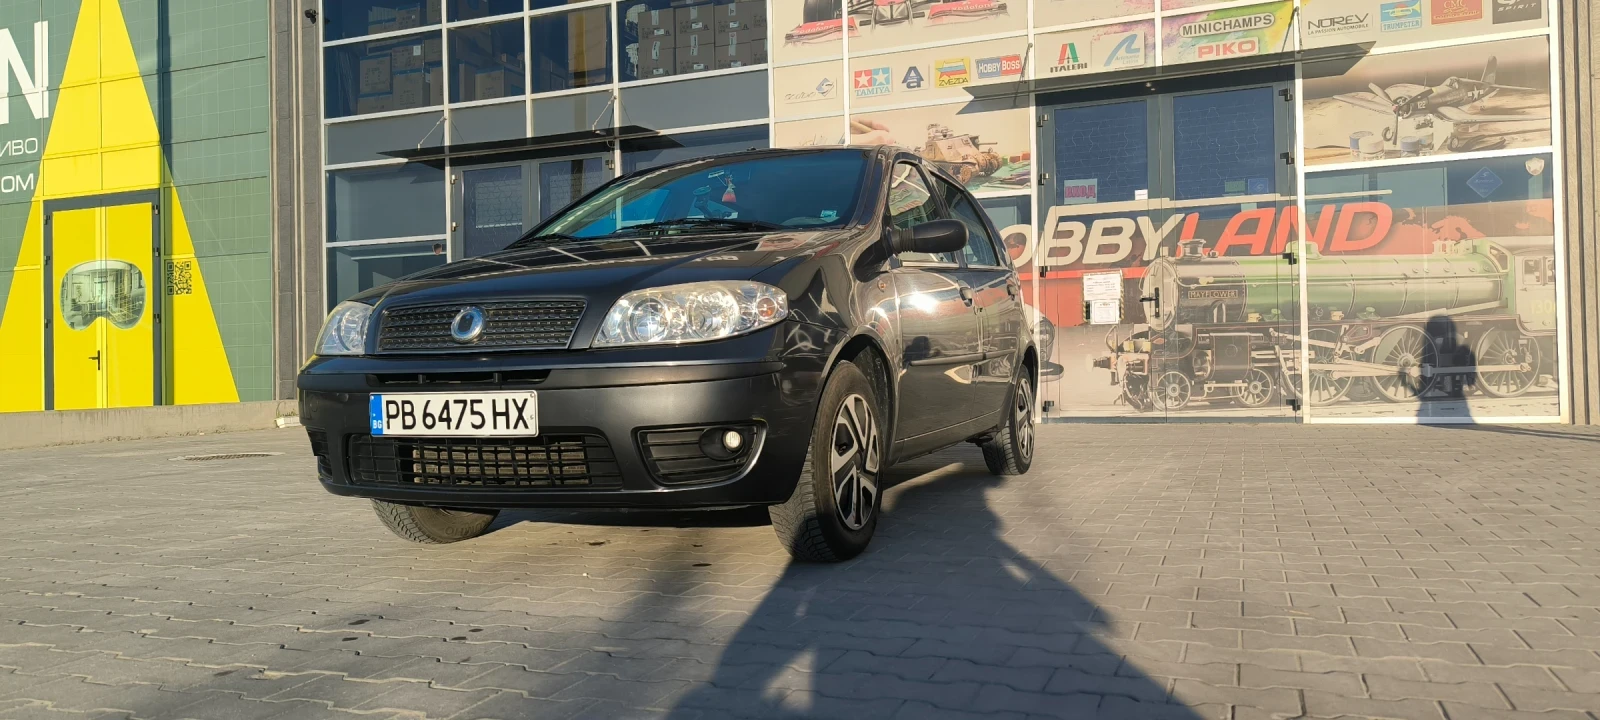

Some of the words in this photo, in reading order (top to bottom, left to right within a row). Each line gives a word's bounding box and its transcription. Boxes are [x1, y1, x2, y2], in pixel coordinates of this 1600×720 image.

[1497, 3, 1537, 12] SPIRIT
[1182, 14, 1273, 36] MINICHAMPS
[1308, 13, 1369, 30] NOREV
[1383, 20, 1420, 31] TRUMPETER
[1315, 27, 1336, 35] PASSION
[1337, 23, 1369, 32] AUTOMOBILE
[1197, 39, 1257, 59] PIKO
[979, 61, 1001, 74] HOBBY
[1001, 59, 1021, 71] BOSS
[1050, 62, 1088, 73] ITALERI
[938, 77, 969, 87] ZVEZDA
[854, 86, 891, 97] TAMIYA
[385, 399, 417, 430] PB
[422, 399, 486, 430] 6475
[492, 398, 529, 430] HX
[372, 420, 383, 429] BG
